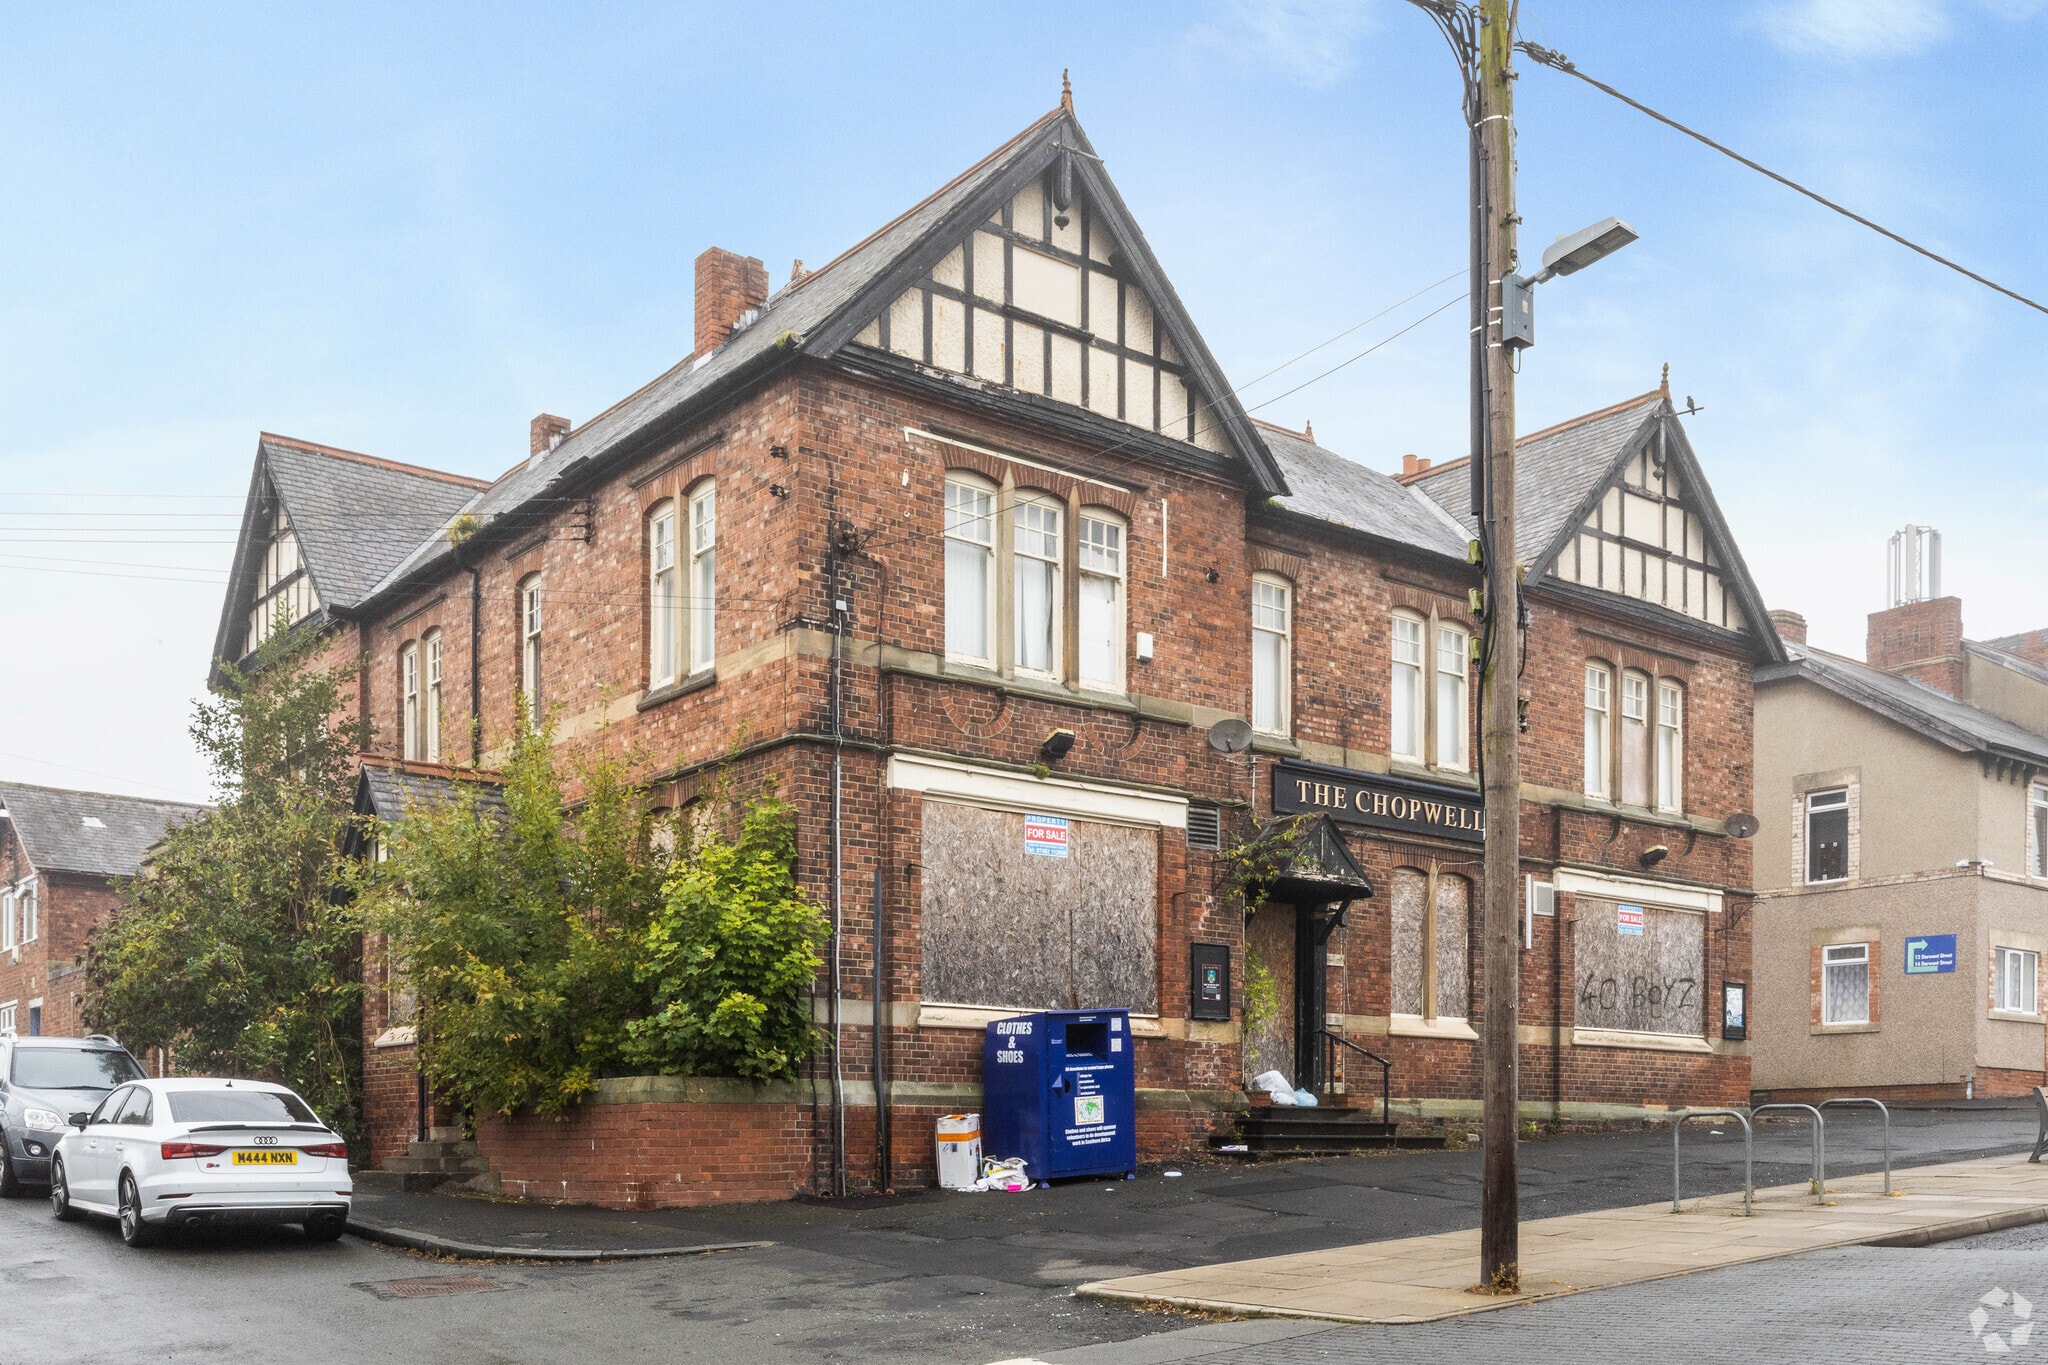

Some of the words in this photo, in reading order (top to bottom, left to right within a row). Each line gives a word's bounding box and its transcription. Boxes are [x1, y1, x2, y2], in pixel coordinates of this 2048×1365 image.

[1296, 779, 1348, 810] THE
[1355, 790, 1485, 833] CHOPWELL
[1026, 814, 1066, 825] PROPERTY
[1027, 827, 1045, 839] FOR
[1045, 829, 1066, 841] SALE
[1619, 913, 1630, 922] FOR
[1630, 914, 1642, 923] SALE
[1580, 971, 1616, 1010] 40
[996, 1021, 1033, 1035] CLOTHES
[1007, 1035, 1017, 1049] &
[996, 1050, 1024, 1063] SHOES
[1066, 1133, 1085, 1141] volunteers
[1094, 1130, 1116, 1138] development
[237, 1152, 267, 1164] M444
[270, 1152, 293, 1163] NXN
